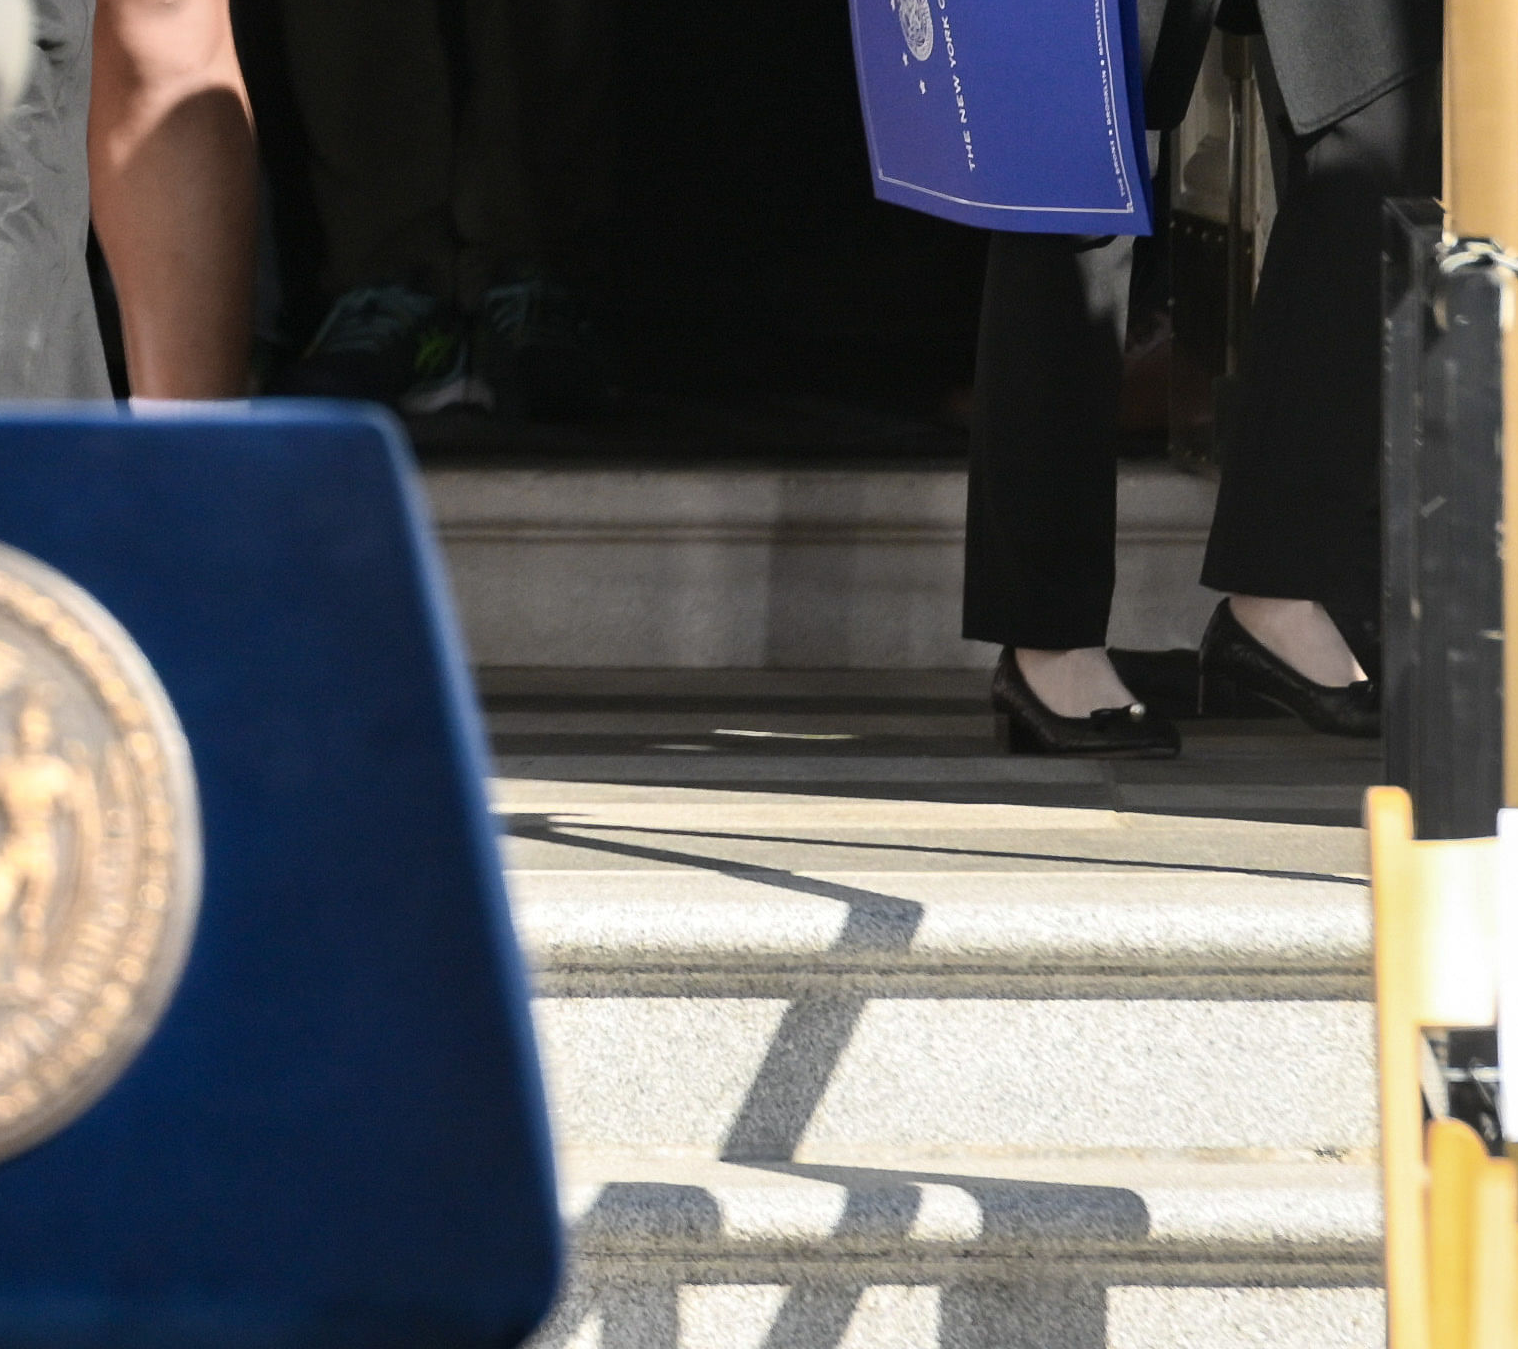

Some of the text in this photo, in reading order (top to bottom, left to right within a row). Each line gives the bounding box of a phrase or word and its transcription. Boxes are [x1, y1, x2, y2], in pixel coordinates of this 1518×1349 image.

[941, 14, 957, 68] YORK
[953, 73, 968, 123] NEW
[964, 129, 976, 170] THE
